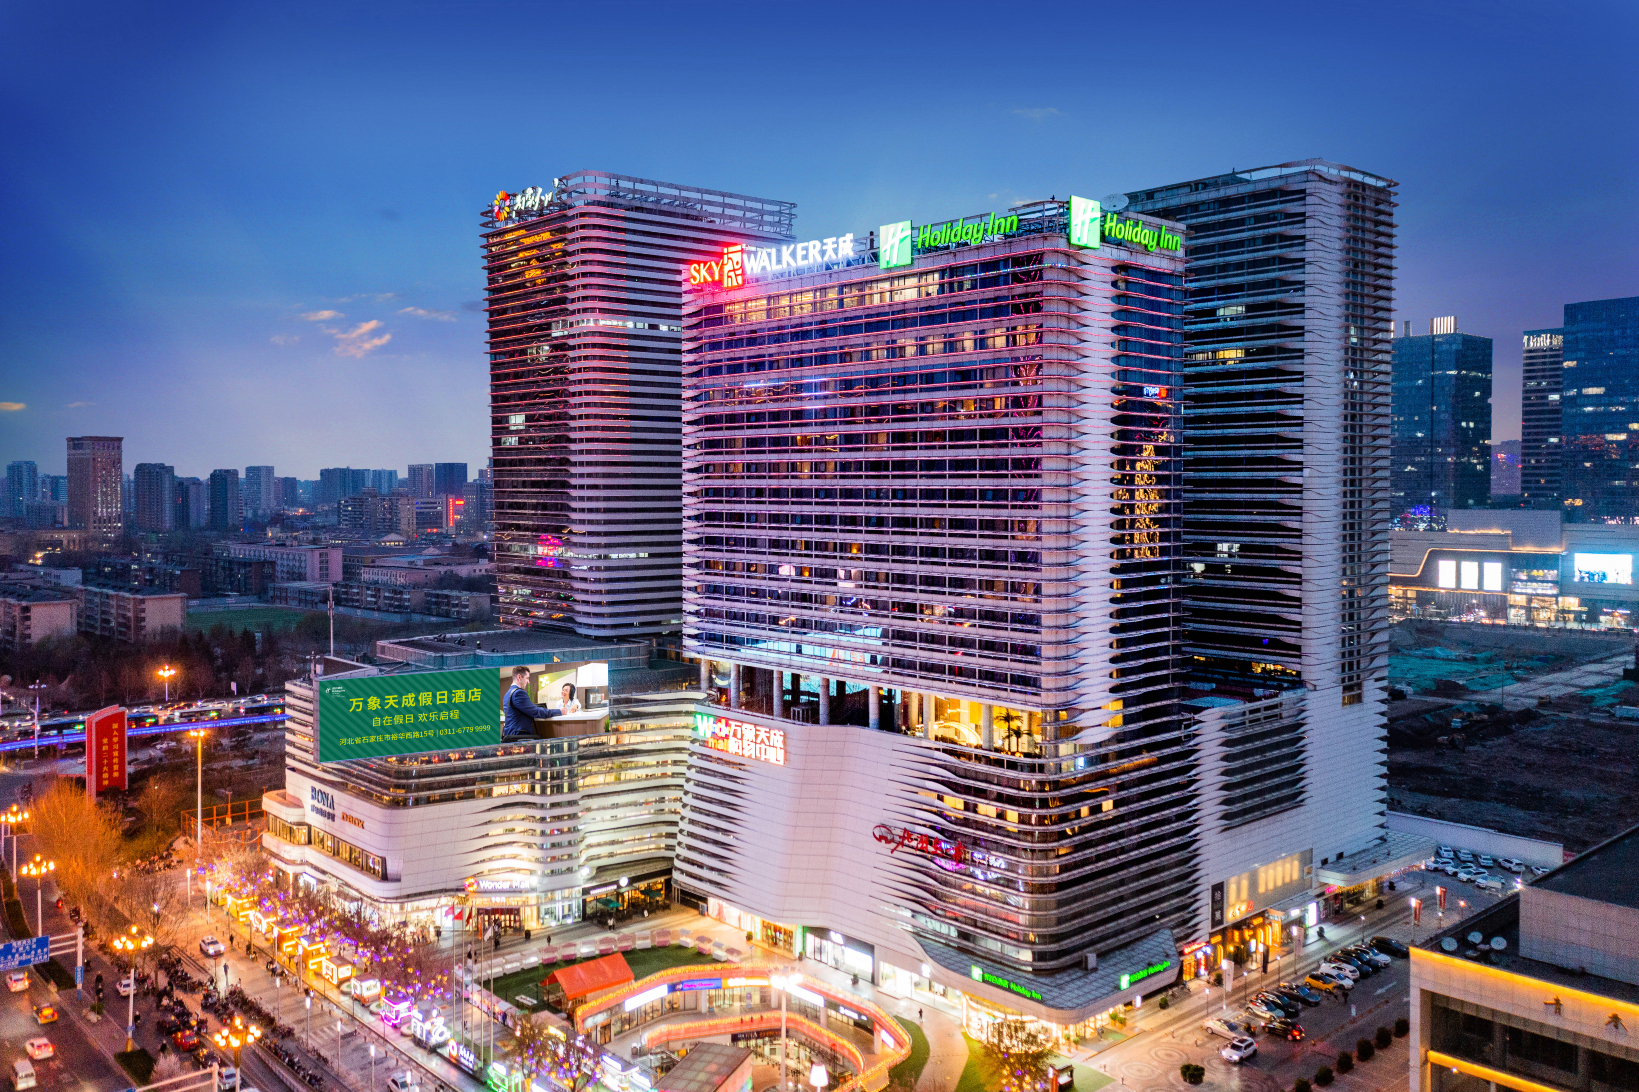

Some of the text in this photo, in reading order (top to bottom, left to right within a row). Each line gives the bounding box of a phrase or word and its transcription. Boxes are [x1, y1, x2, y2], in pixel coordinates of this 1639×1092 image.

[917, 212, 1018, 248] Holiday Inn
[1104, 212, 1181, 252] Holiday Inn
[690, 260, 723, 285] SKY
[349, 688, 482, 713] 万象天成假日酒店
[372, 709, 460, 727] 自在假日 欢乐启程
[729, 720, 785, 748] 万象天成
[311, 786, 335, 811] BONA
[478, 879, 530, 890] Wonder Mall
